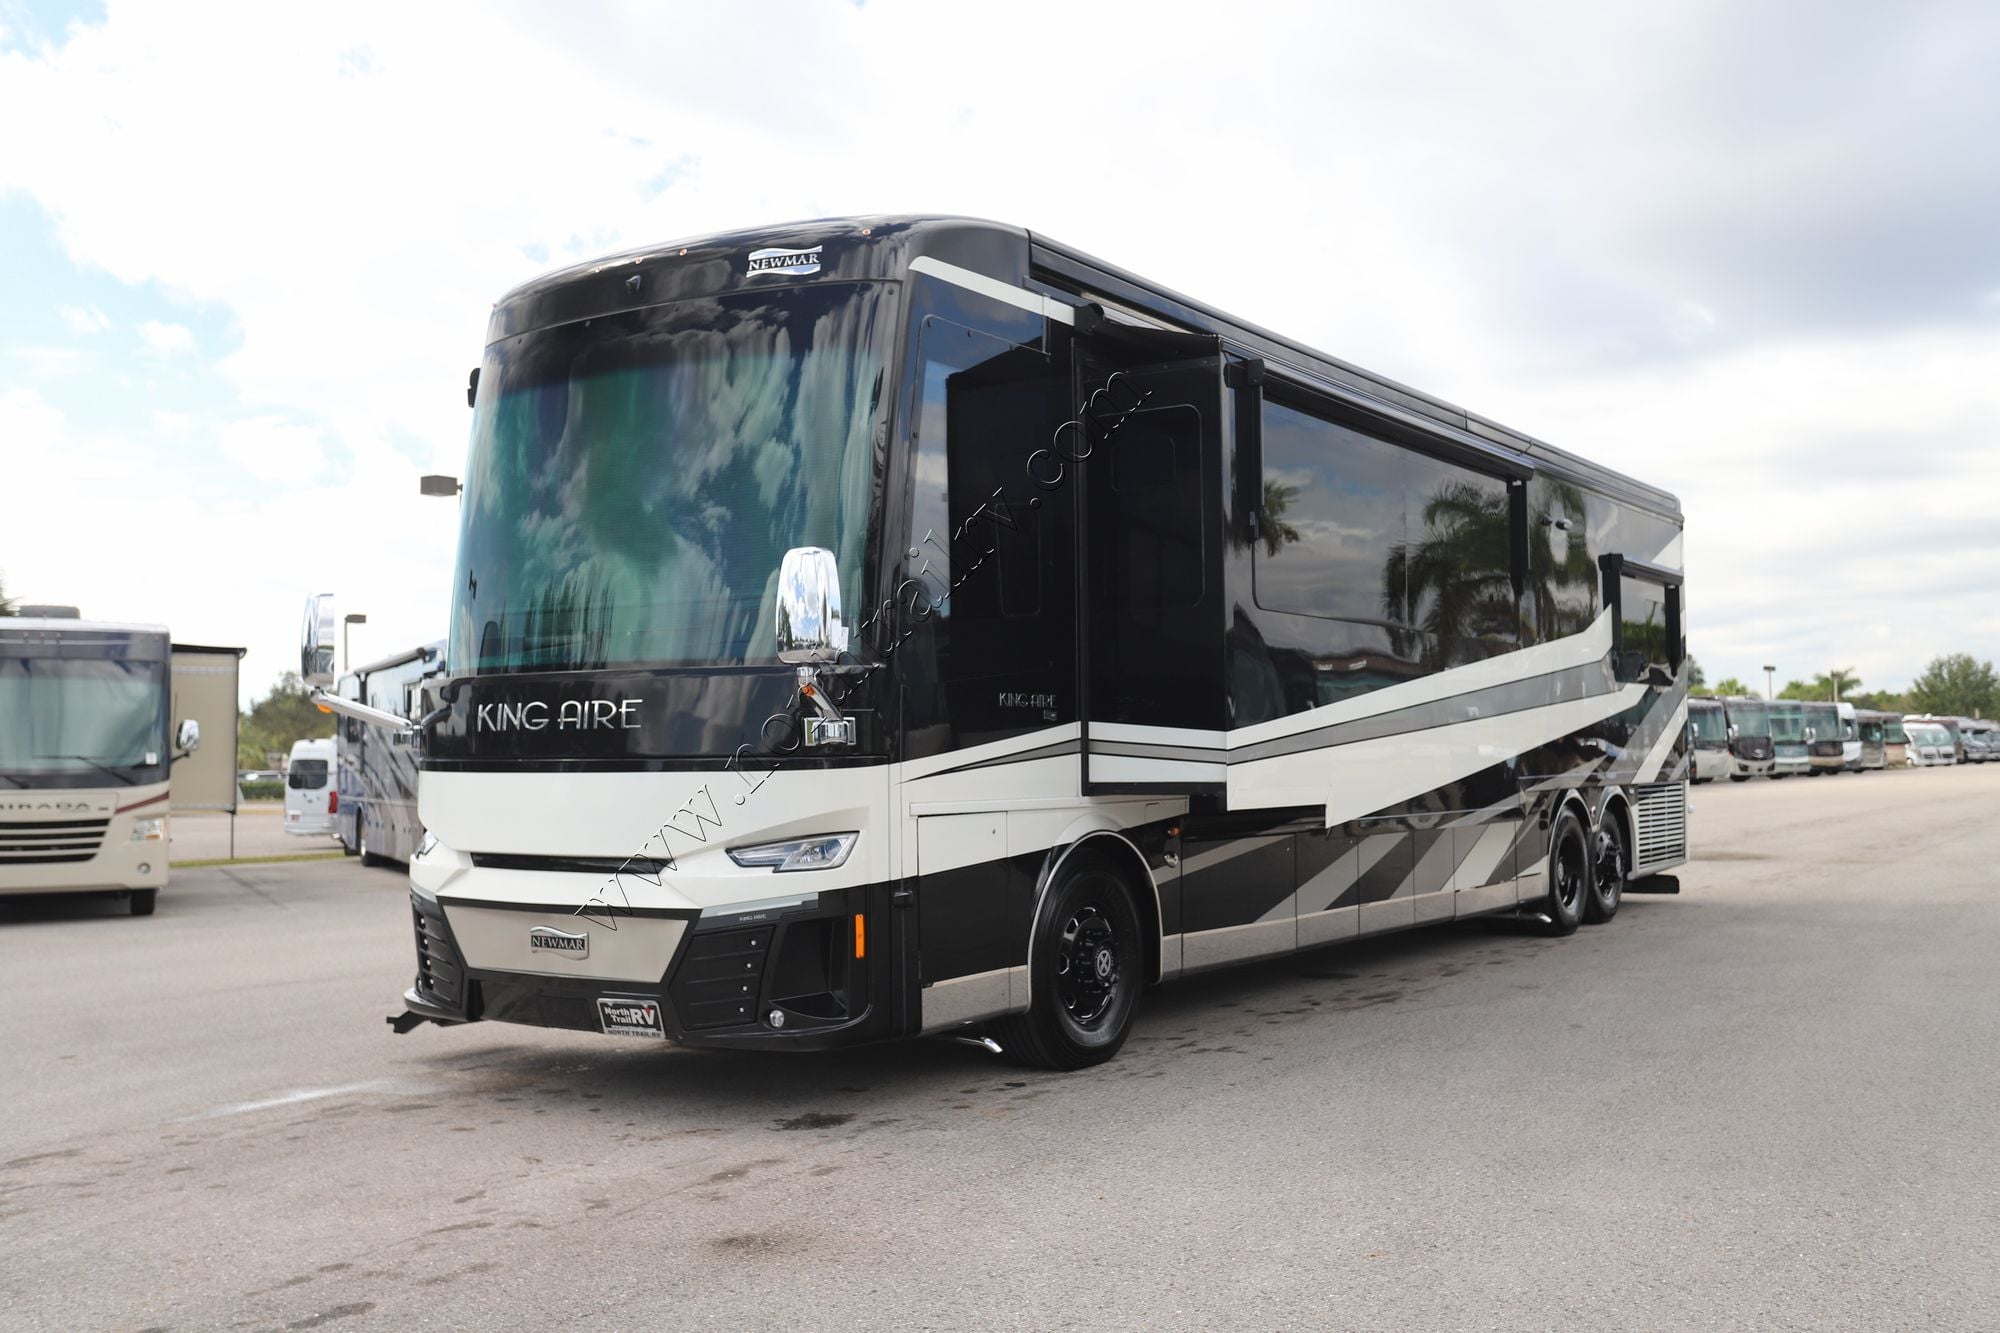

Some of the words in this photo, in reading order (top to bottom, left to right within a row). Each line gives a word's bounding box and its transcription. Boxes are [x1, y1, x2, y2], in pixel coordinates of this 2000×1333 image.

[748, 253, 820, 271] NEWMAR
[999, 692, 1028, 707] KING
[1030, 694, 1057, 708] AIRE
[477, 701, 550, 732] KING
[557, 699, 643, 730] AIRE
[532, 936, 585, 950] NEWMAR
[604, 1007, 631, 1017] North
[610, 1014, 632, 1024] Trail
[629, 1008, 655, 1025] RV
